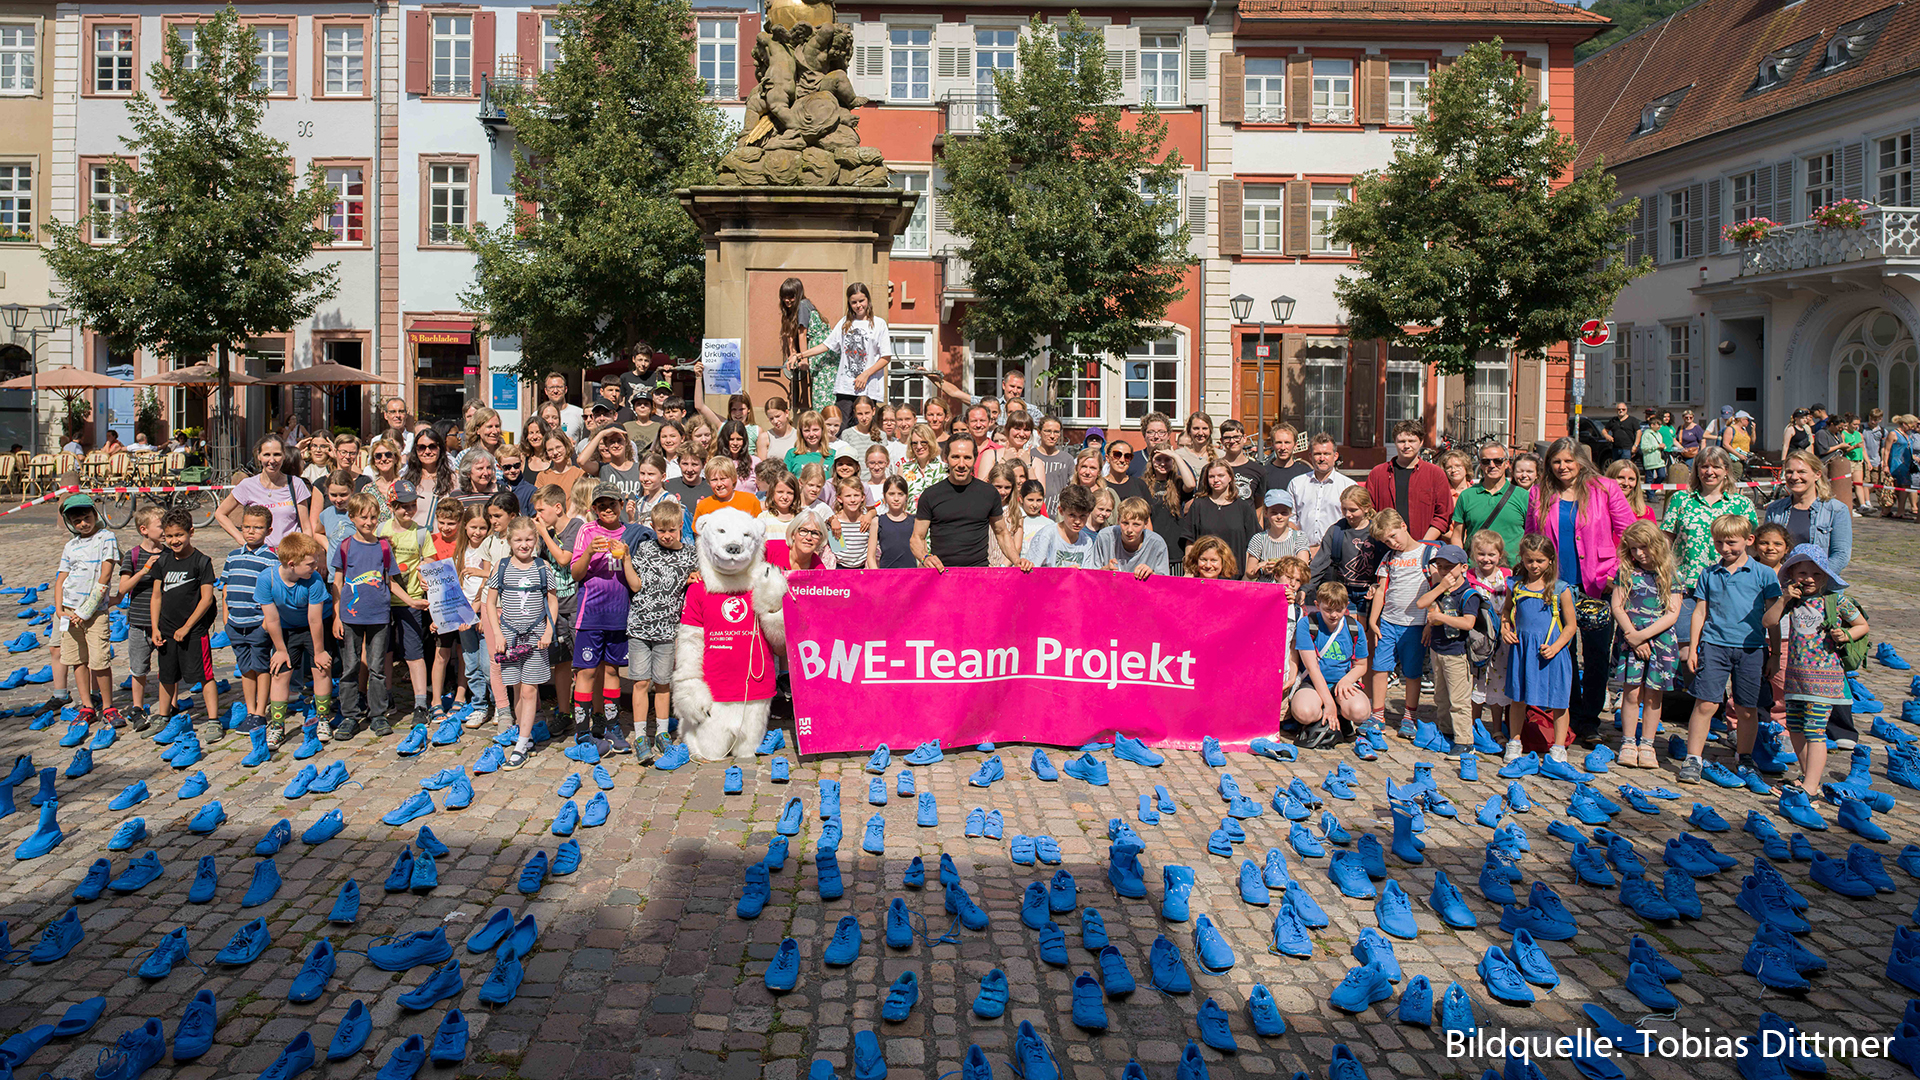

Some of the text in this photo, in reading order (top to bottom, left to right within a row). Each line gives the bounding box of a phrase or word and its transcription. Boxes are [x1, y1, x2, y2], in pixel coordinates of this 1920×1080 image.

[419, 334, 459, 343] Buchladen
[704, 342, 728, 350] Sieger
[164, 571, 189, 583] NIKE
[421, 566, 445, 577] Sieger
[427, 575, 455, 588] Urkunde
[797, 636, 1196, 690] BNE-Team Projekt
